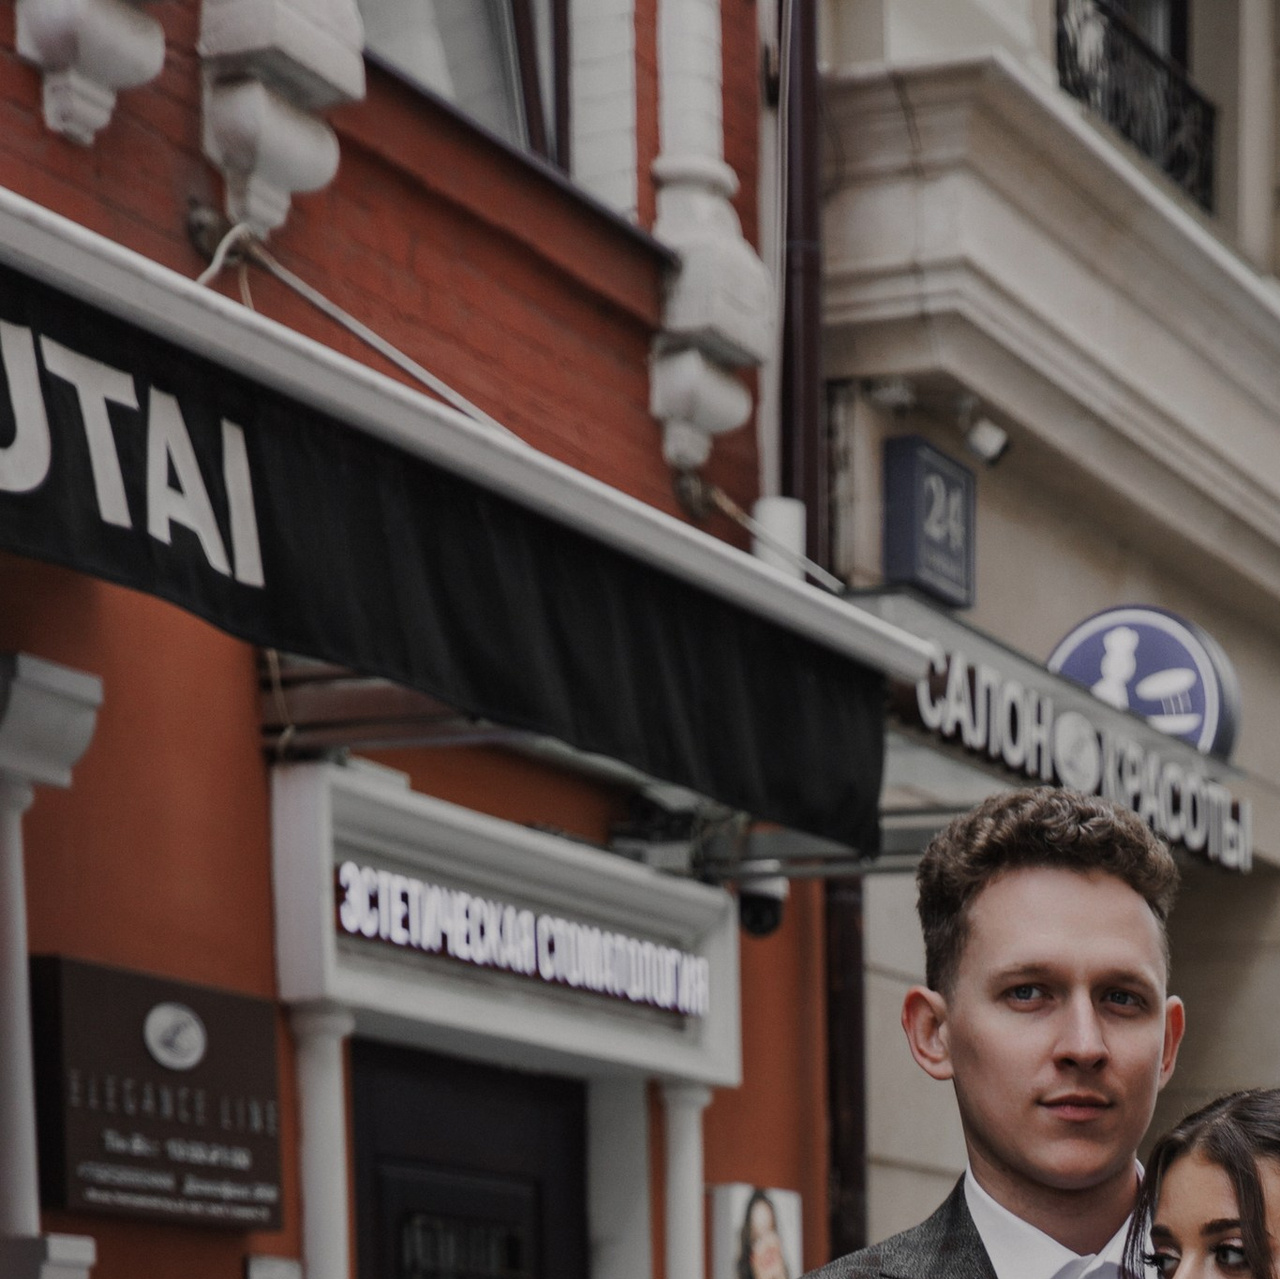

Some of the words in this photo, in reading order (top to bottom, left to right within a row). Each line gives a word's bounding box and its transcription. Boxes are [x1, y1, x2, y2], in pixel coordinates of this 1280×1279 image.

[916, 650, 1054, 782] САЛОН
[1101, 730, 1254, 874] КРАСОТЫ
[339, 861, 537, 976] ЭСТЕТИЧЕСКАЯ
[536, 914, 709, 1016] СТОМАТОЛОГИЯ
[69, 1069, 206, 1127] ELEGANCE
